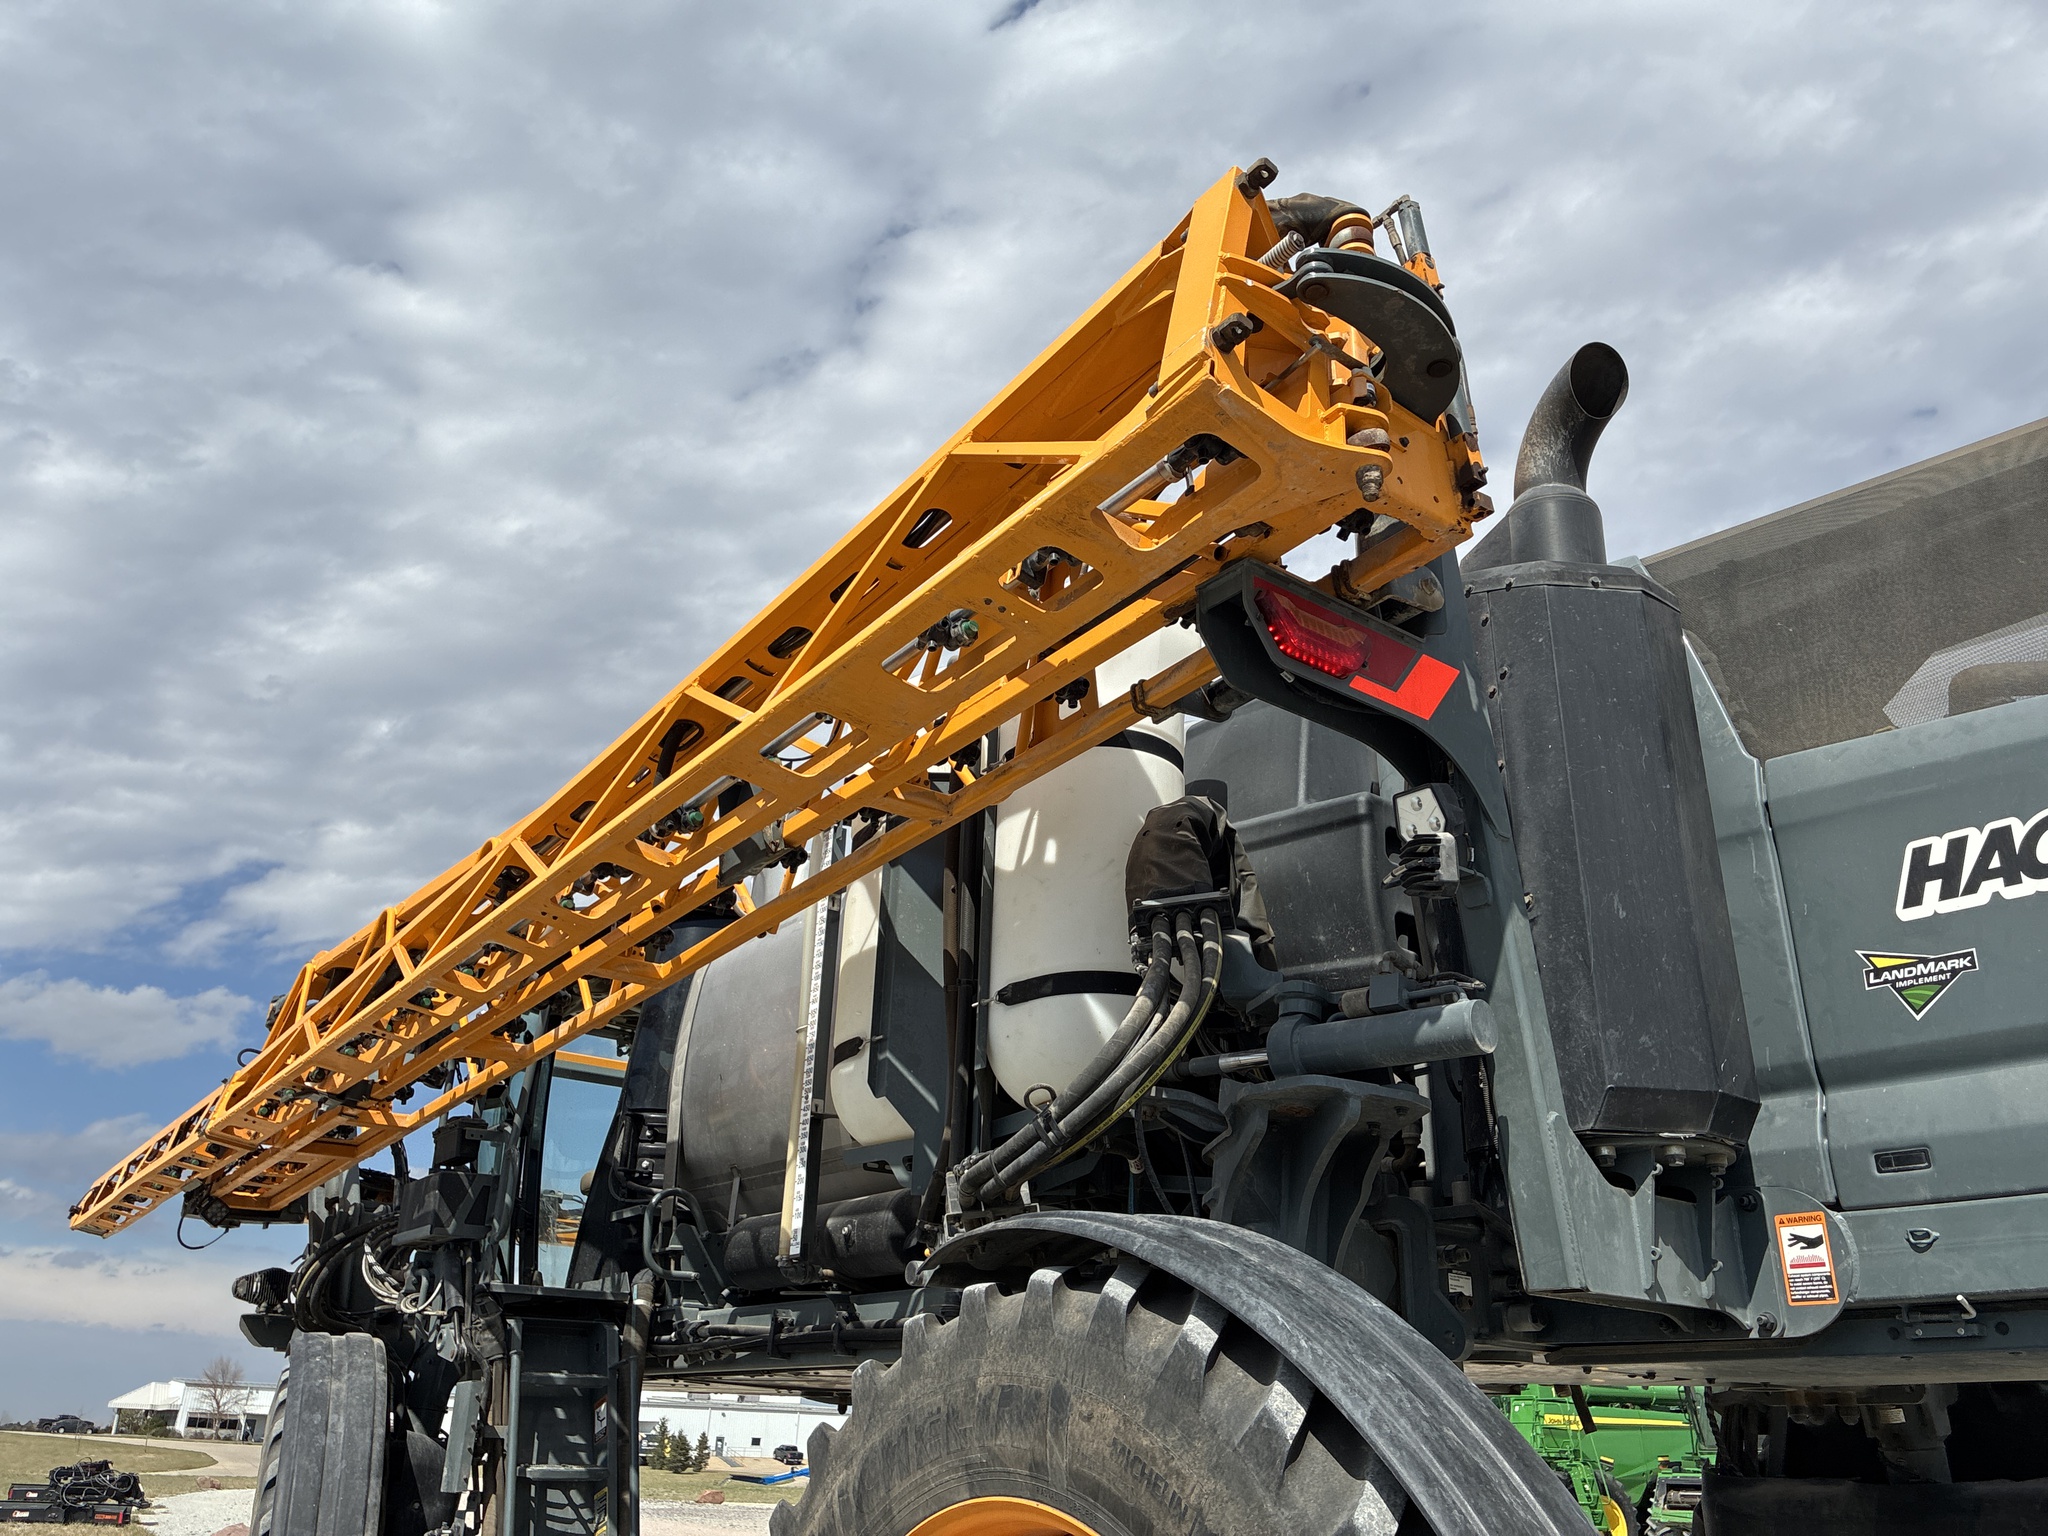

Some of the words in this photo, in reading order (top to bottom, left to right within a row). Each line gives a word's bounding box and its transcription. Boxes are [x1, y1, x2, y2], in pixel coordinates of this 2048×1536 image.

[1868, 955, 1973, 985] LANDMARK
[1895, 972, 1952, 988] IMPLEMENT
[1785, 1213, 1823, 1225] WARNING
[1109, 1436, 1190, 1521] MICHELIN
